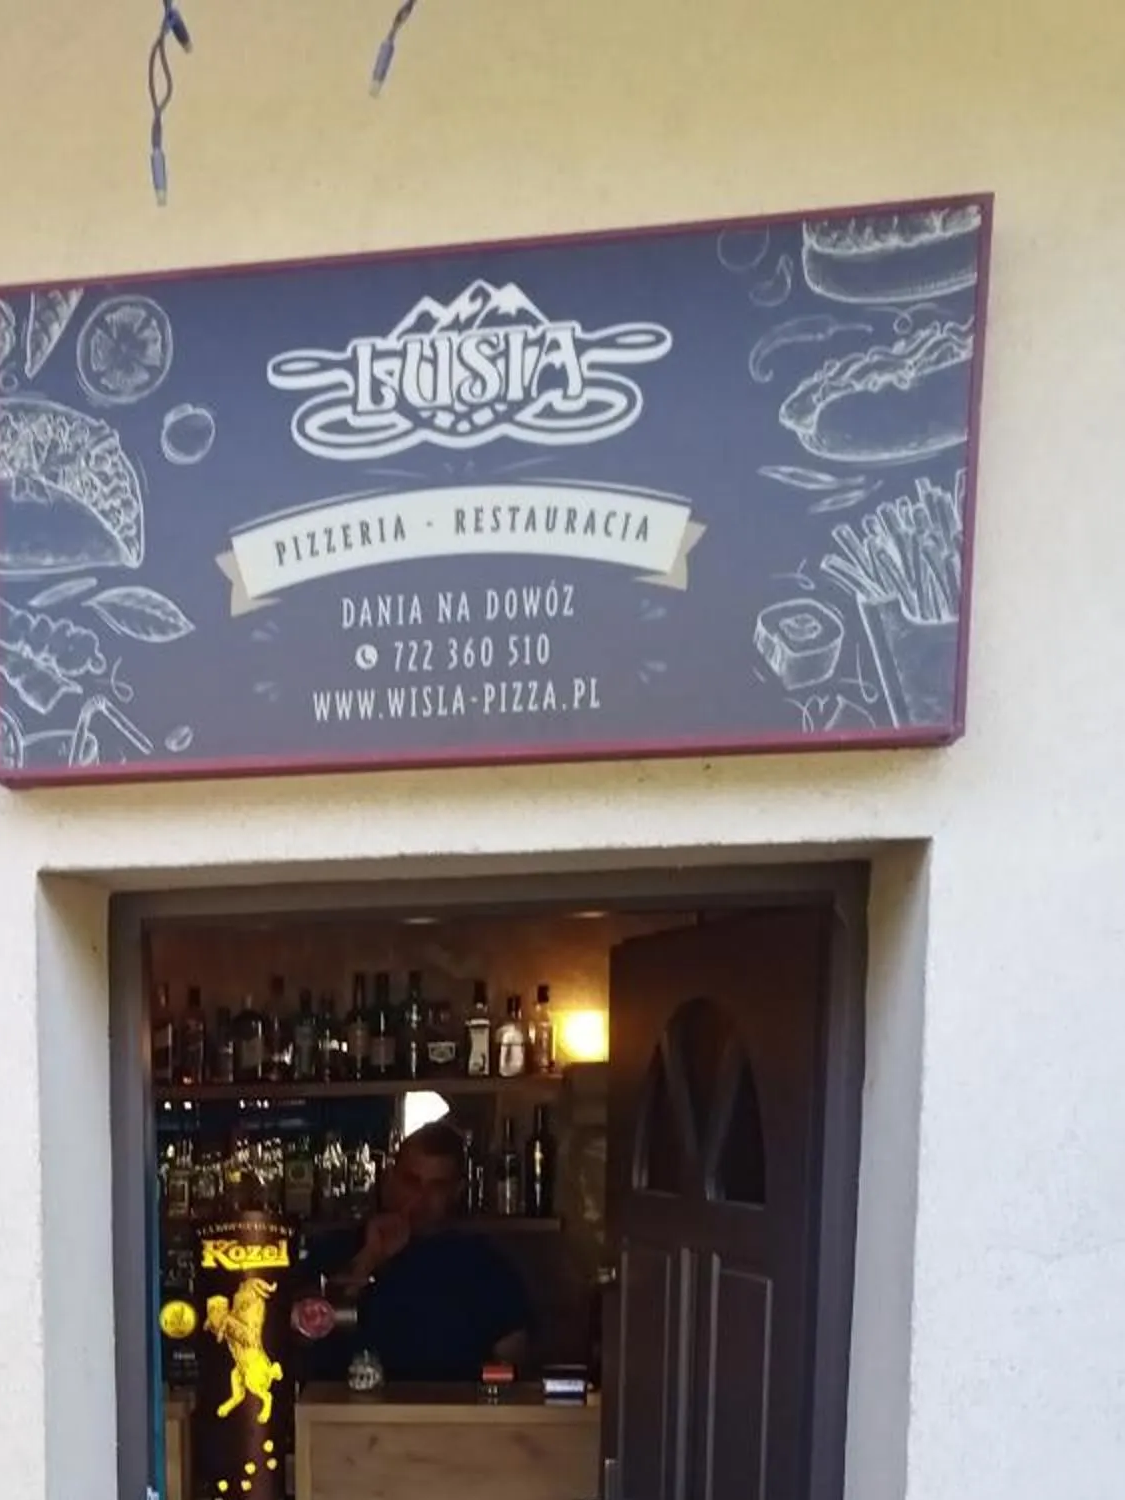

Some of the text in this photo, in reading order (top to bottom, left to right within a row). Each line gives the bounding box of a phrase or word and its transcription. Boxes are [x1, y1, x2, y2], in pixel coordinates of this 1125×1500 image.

[275, 513, 406, 566] PIZZERIA
[341, 579, 575, 629] DANIA NA DOWÓZ
[394, 633, 550, 672] 722 360 510
[313, 677, 601, 722] WWW.WISLA-PIZZA.PL
[201, 1239, 290, 1271] Kozel
